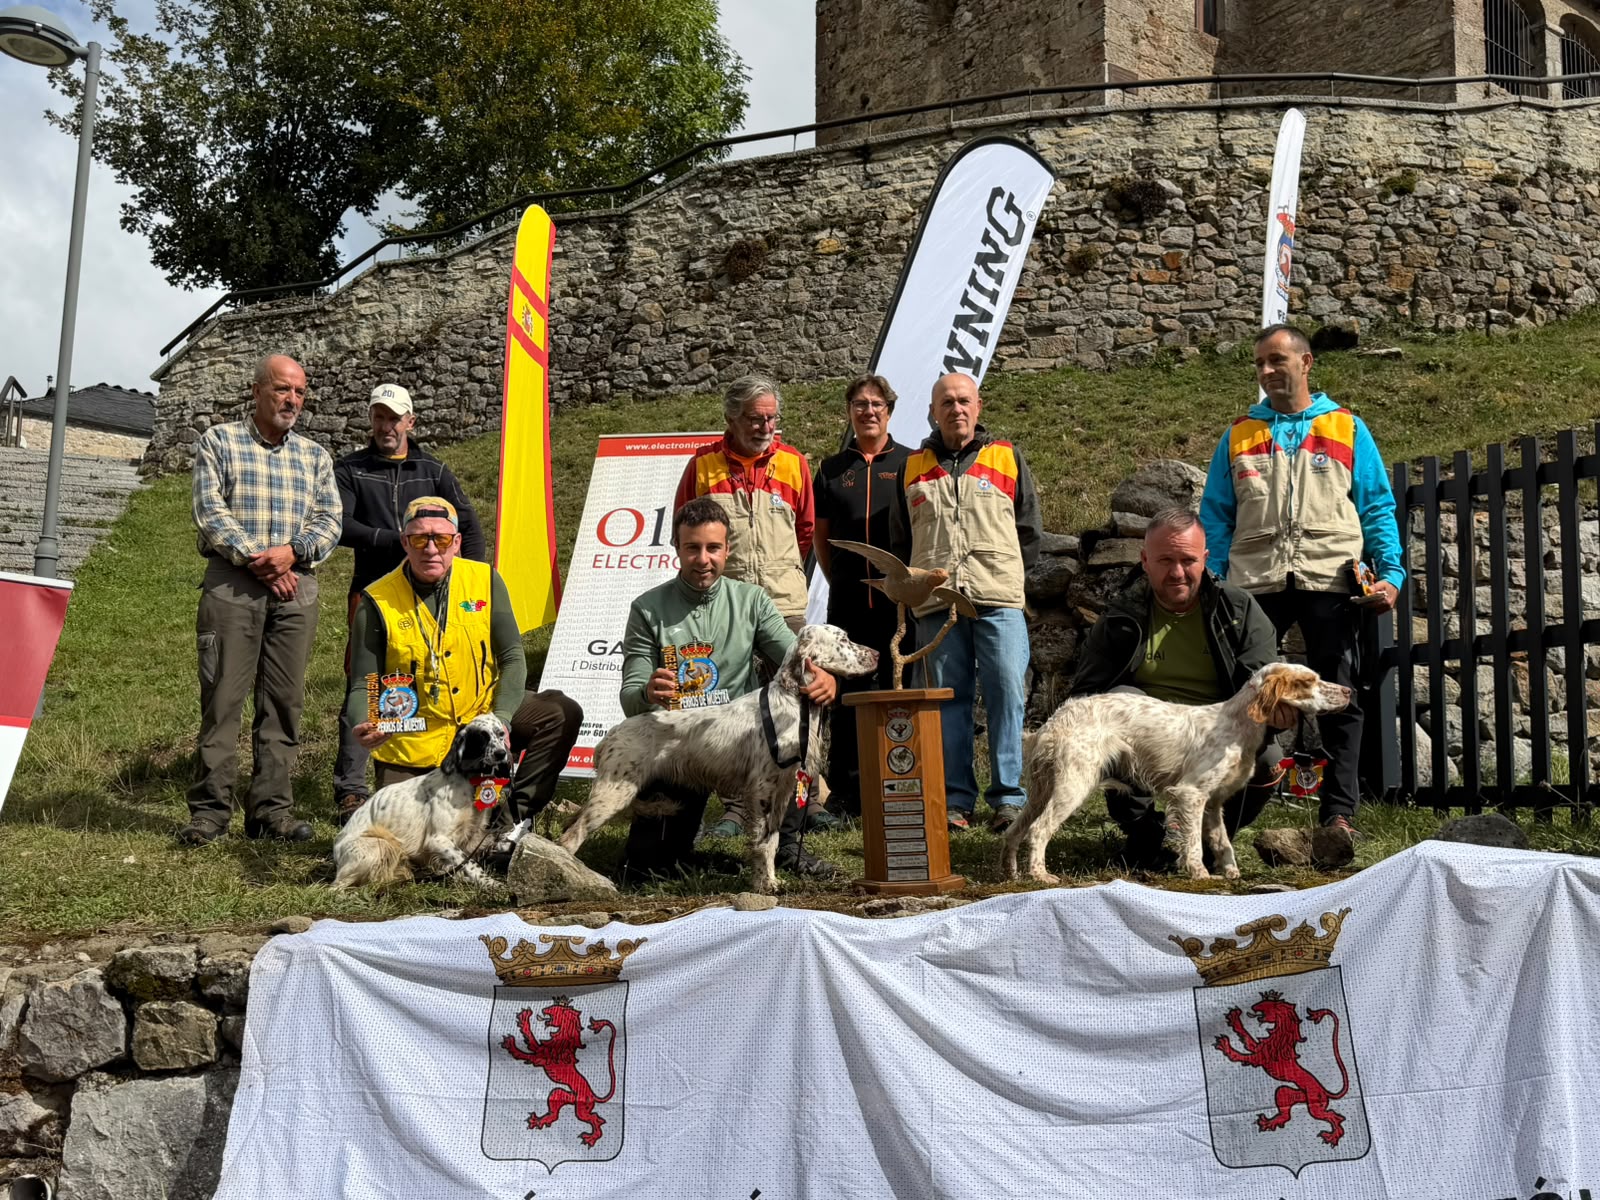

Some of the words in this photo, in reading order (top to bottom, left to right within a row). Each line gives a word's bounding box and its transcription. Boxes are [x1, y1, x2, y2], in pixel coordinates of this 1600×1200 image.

[927, 185, 1026, 431] WNING
[625, 441, 715, 451] www.electronica
[596, 506, 673, 547] Ol
